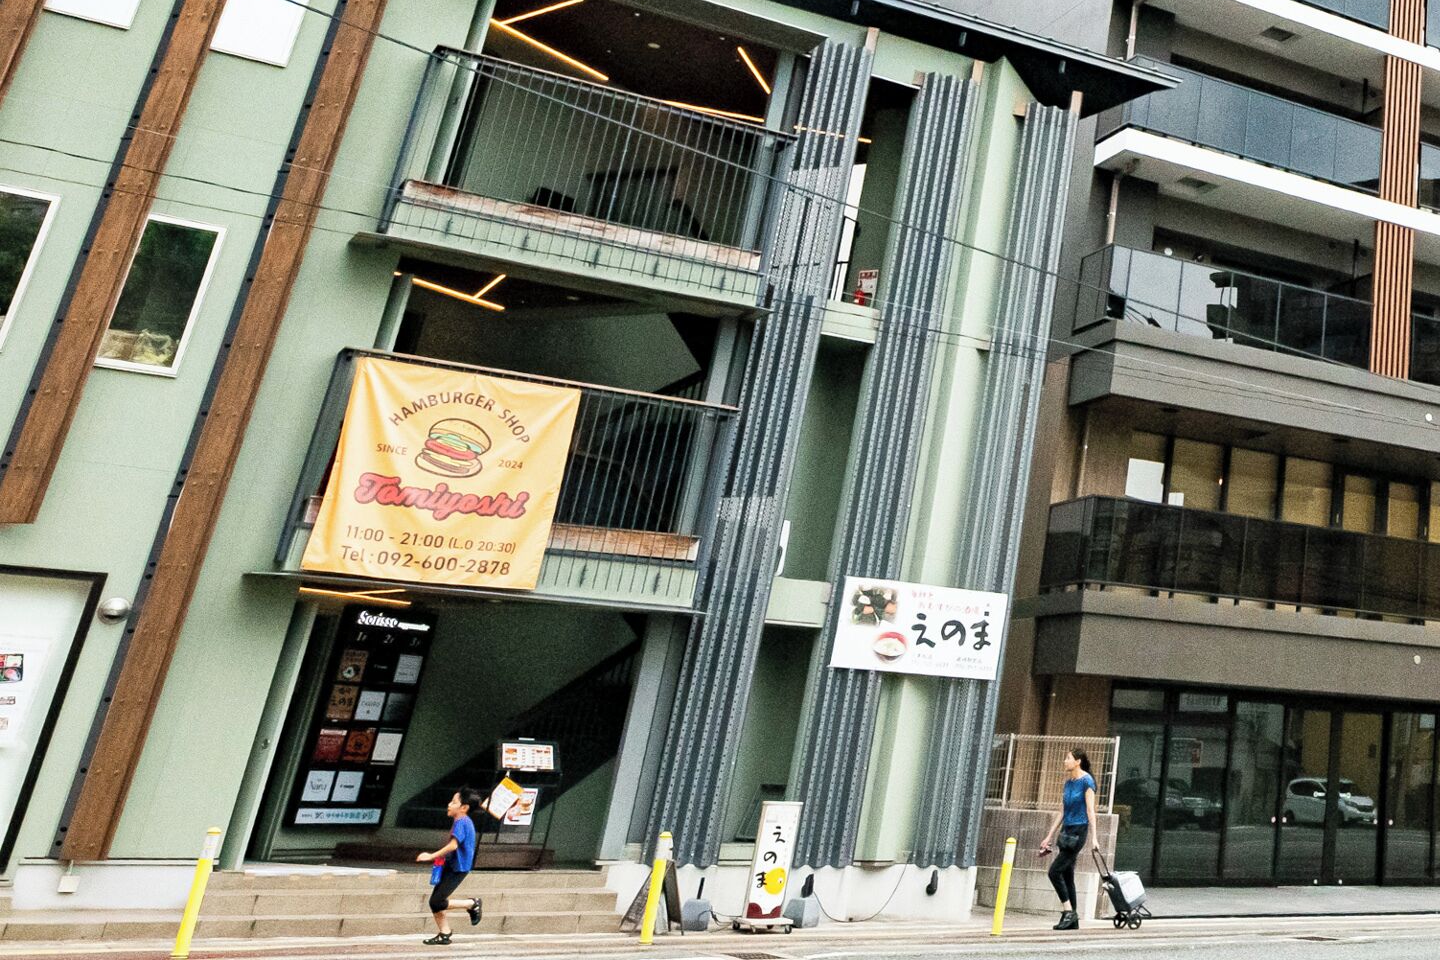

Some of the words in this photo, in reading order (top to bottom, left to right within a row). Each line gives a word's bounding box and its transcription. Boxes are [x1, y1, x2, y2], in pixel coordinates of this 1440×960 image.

[388, 391, 496, 427] HAMBURGER
[498, 408, 530, 445] SHOP
[375, 442, 407, 456] SINCE
[498, 459, 524, 470] 2024
[354, 472, 530, 521] Tomiyoshi
[346, 525, 384, 542] 11:00
[400, 531, 445, 548] 21:00
[477, 540, 516, 555] 20:30)
[911, 613, 992, 651] えのま
[755, 825, 786, 889] えのま
